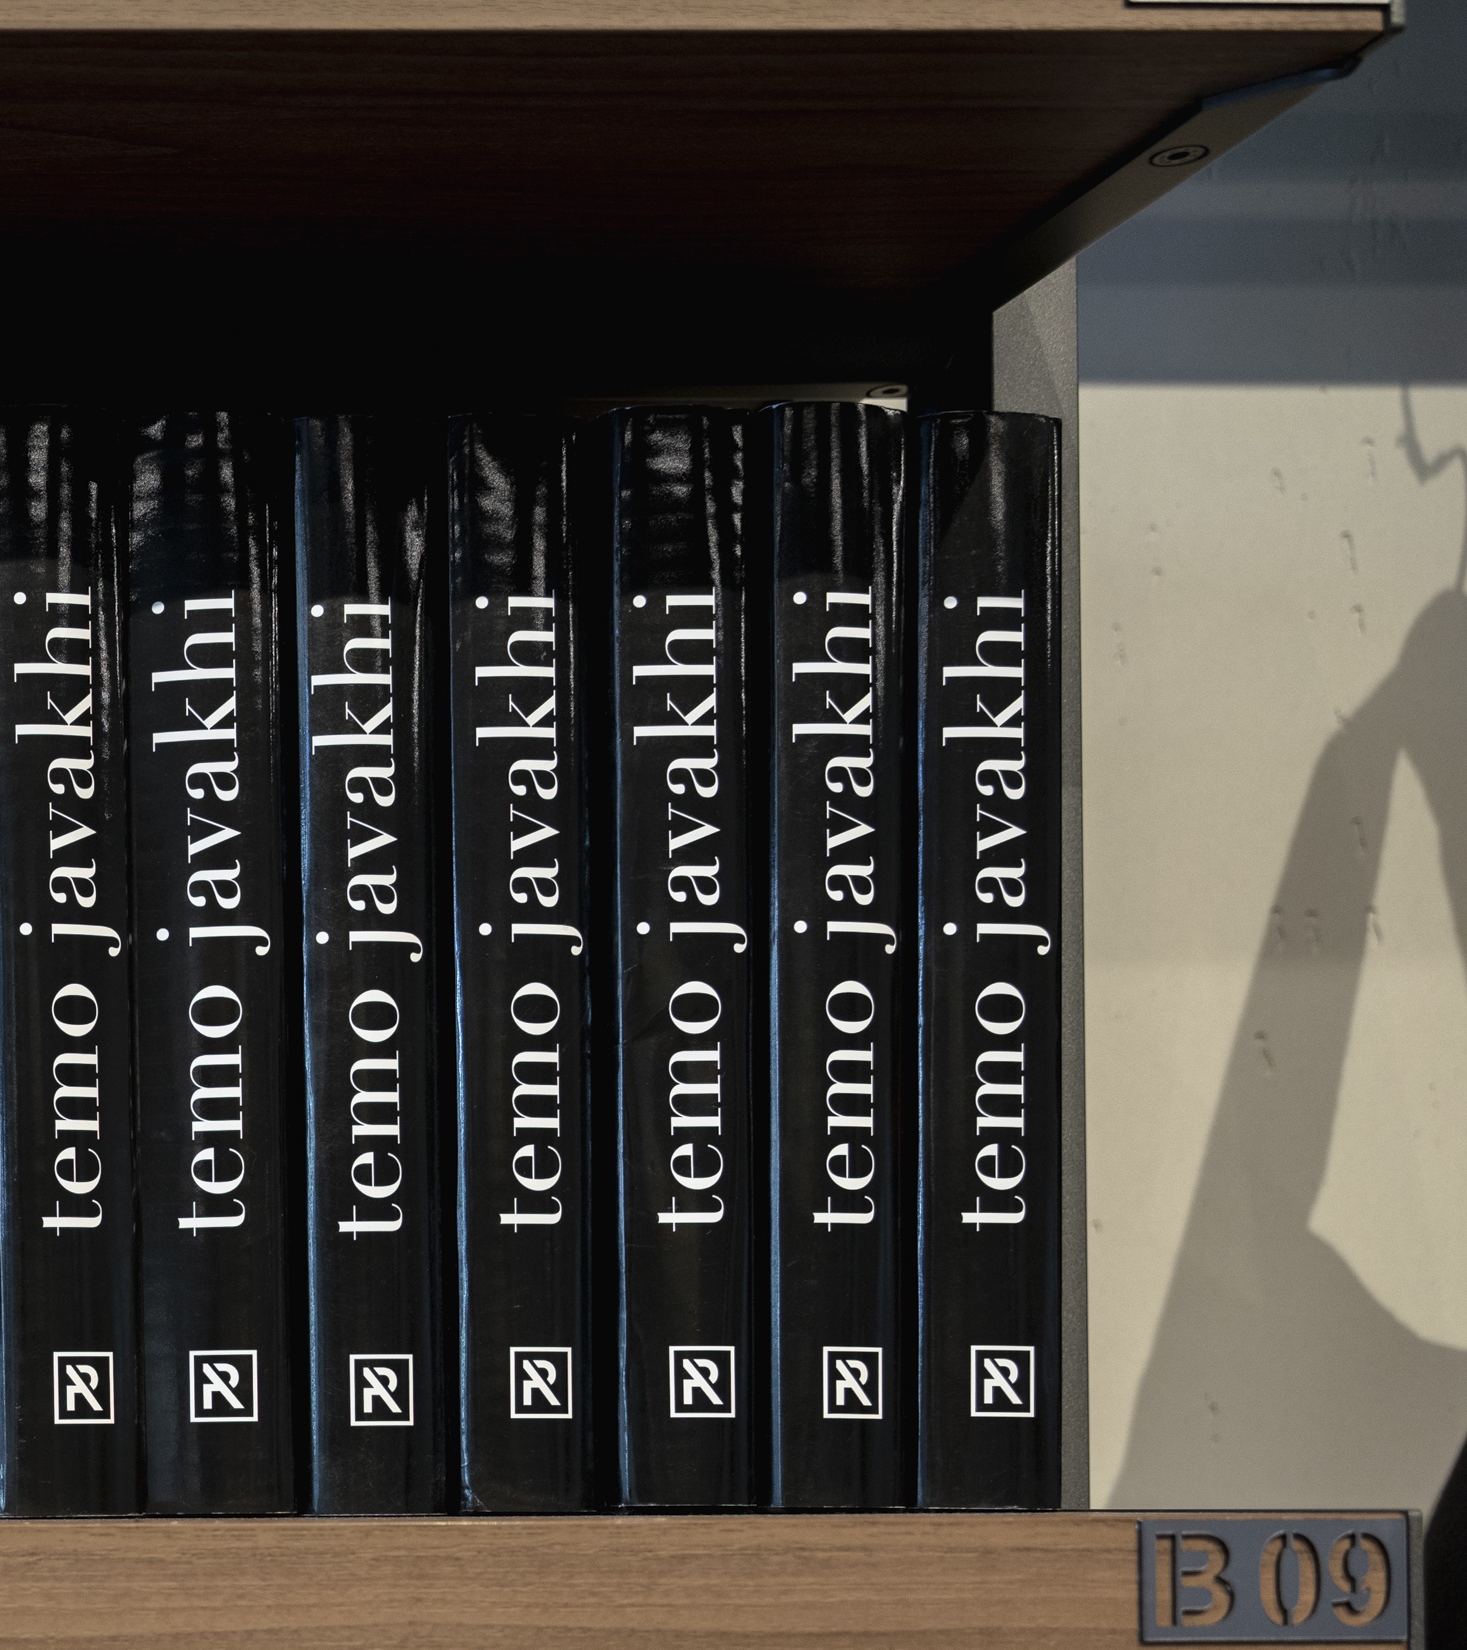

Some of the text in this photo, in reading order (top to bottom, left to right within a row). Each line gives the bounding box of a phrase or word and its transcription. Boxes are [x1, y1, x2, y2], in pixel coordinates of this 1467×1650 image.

[13, 586, 122, 1237] temo javakhi
[151, 589, 271, 1237] temo javakhi
[310, 597, 423, 1241] temo javakhi
[474, 589, 584, 1233] temo javakhi
[632, 586, 748, 1232] temo javakhi
[792, 585, 897, 1232] temo javakhi
[942, 589, 1051, 1232] temo javakhi
[1154, 1529, 1392, 1628] B 09
